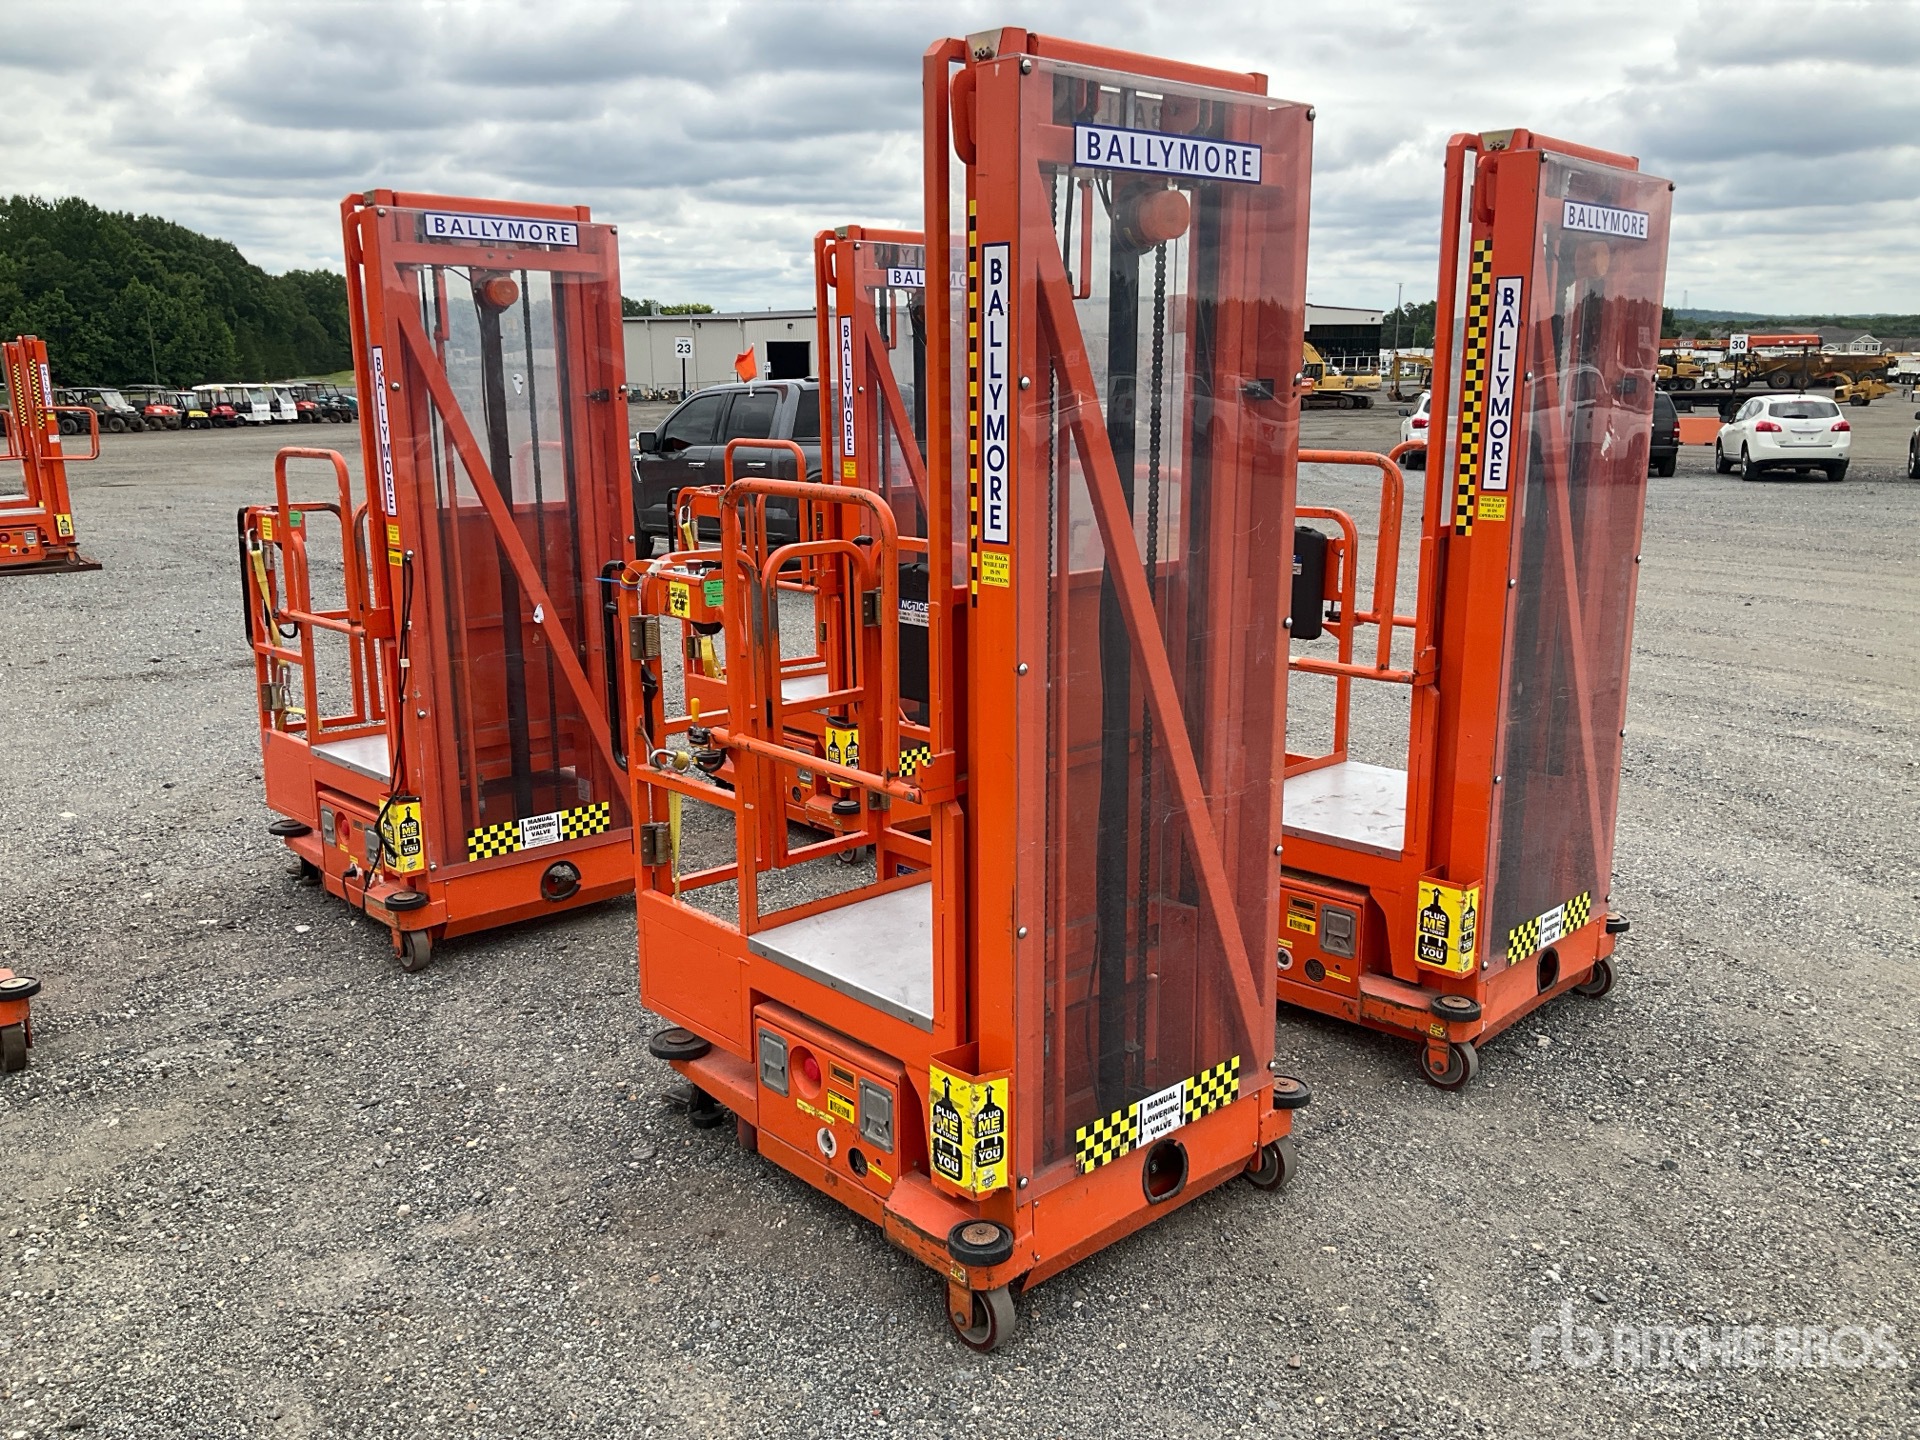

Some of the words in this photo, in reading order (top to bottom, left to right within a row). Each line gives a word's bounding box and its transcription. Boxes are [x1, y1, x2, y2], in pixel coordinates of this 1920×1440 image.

[1087, 131, 1252, 177] BALLYMORE
[1568, 205, 1645, 236] BALLYMORE
[434, 217, 571, 243] BALLYMORE
[676, 343, 691, 354] 23
[1731, 340, 1746, 350] 30
[843, 325, 853, 451] BALLYMORE
[1489, 287, 1515, 481] BALLYMORE
[986, 258, 1005, 530] BALLYMORE
[375, 356, 395, 510] BALLYMORE
[998, 562, 1008, 570] LIFT
[982, 575, 1009, 584] OPERATION
[901, 599, 929, 612] NOTICE
[401, 821, 417, 829] PLUG
[525, 820, 556, 832] LOWERING
[527, 815, 554, 825] MANUAL
[402, 827, 417, 835] ME
[530, 828, 551, 837] VALVE
[403, 845, 419, 853] YOU
[1423, 910, 1447, 922] PLUG
[1423, 916, 1447, 932] ME
[1422, 946, 1444, 960] YOU
[1147, 1091, 1177, 1111] MANUAL
[936, 1105, 959, 1122] PLUG
[978, 1109, 1001, 1122] PLUG
[1143, 1102, 1180, 1126] LOWERING
[937, 1115, 959, 1137] ME
[978, 1117, 1001, 1132] ME
[1150, 1118, 1172, 1135] VALVE
[942, 1130, 959, 1143] TODAY
[984, 1128, 1000, 1136] TODAY
[978, 1148, 1001, 1161] YOU
[936, 1153, 959, 1173] YOU
